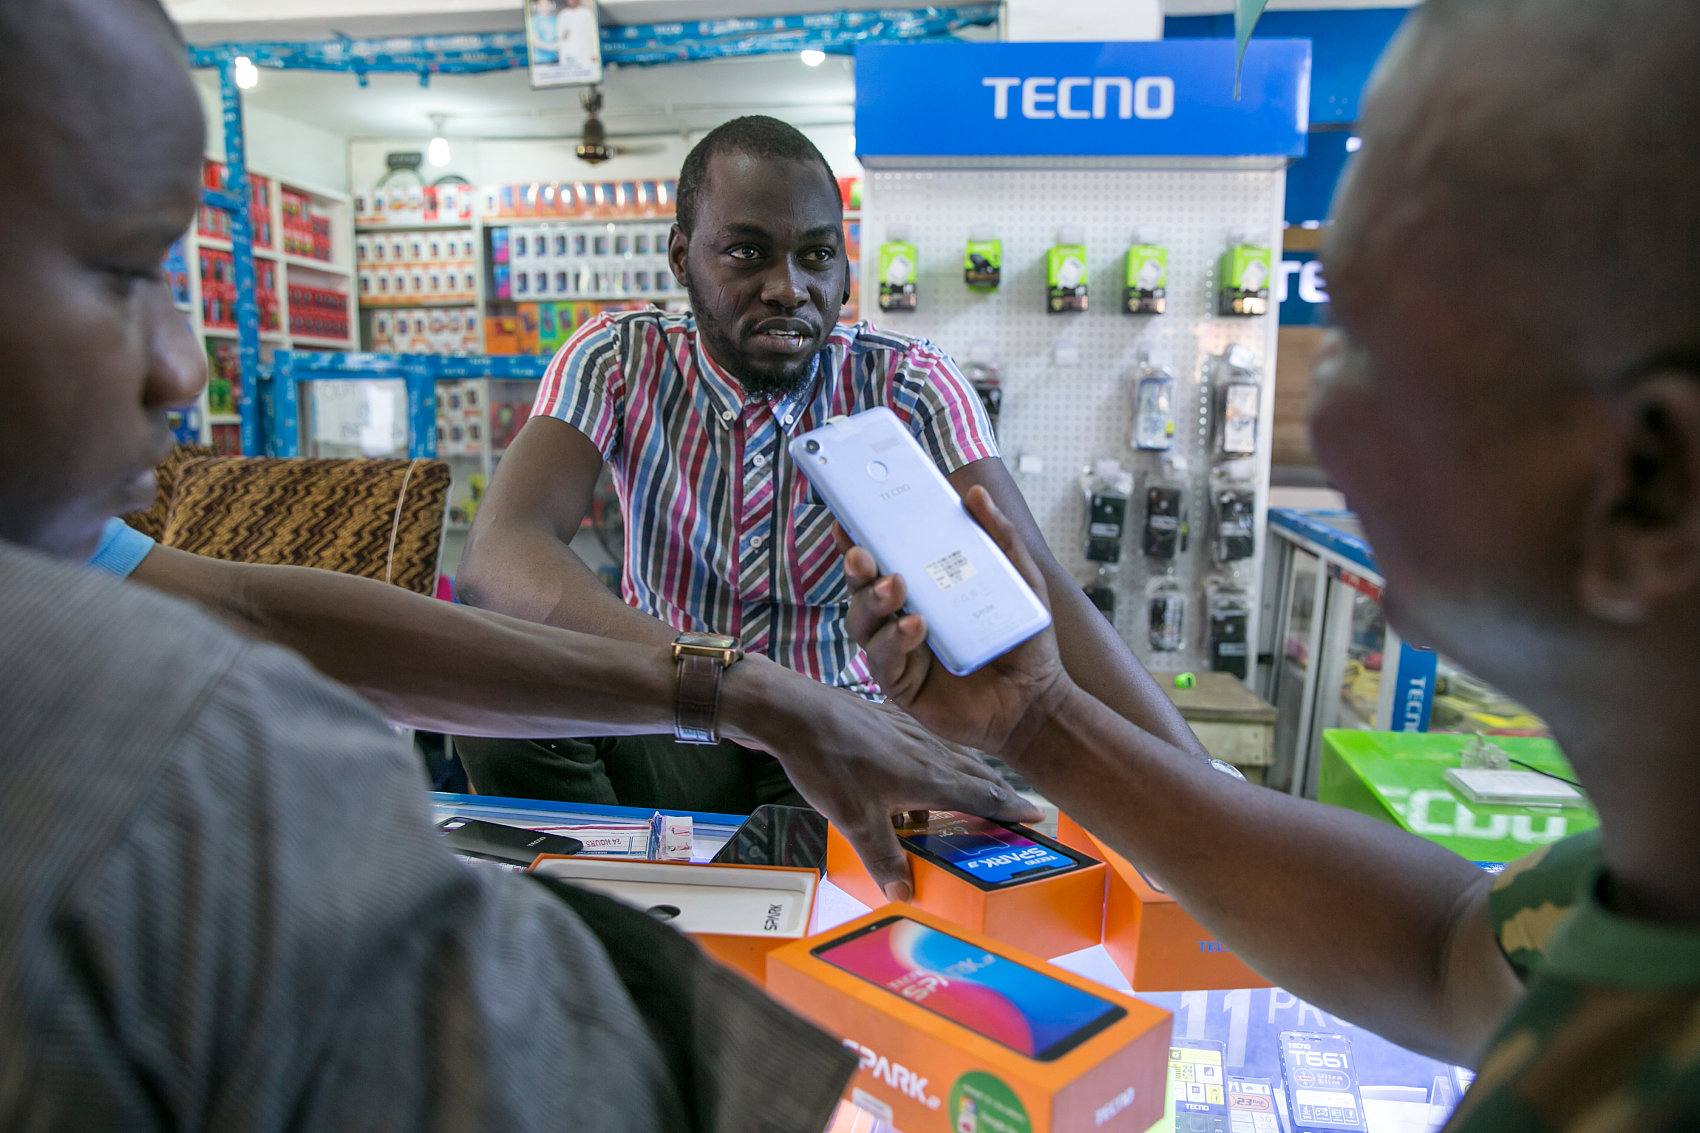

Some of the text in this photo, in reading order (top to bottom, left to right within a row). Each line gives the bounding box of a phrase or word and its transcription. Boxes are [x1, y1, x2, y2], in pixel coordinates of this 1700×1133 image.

[983, 77, 1175, 119] TECNO
[1403, 675, 1427, 732] TECN
[586, 839, 610, 848] HOURS
[980, 847, 1047, 868] SPARK
[1025, 855, 1059, 866] TECNO
[764, 903, 783, 931] SPARK
[1181, 987, 1353, 1067] 11 PR
[1286, 1042, 1311, 1050] TECNO
[1288, 1050, 1348, 1069] T661
[1185, 1103, 1210, 1111] TECNO
[1236, 1097, 1252, 1106] 23
